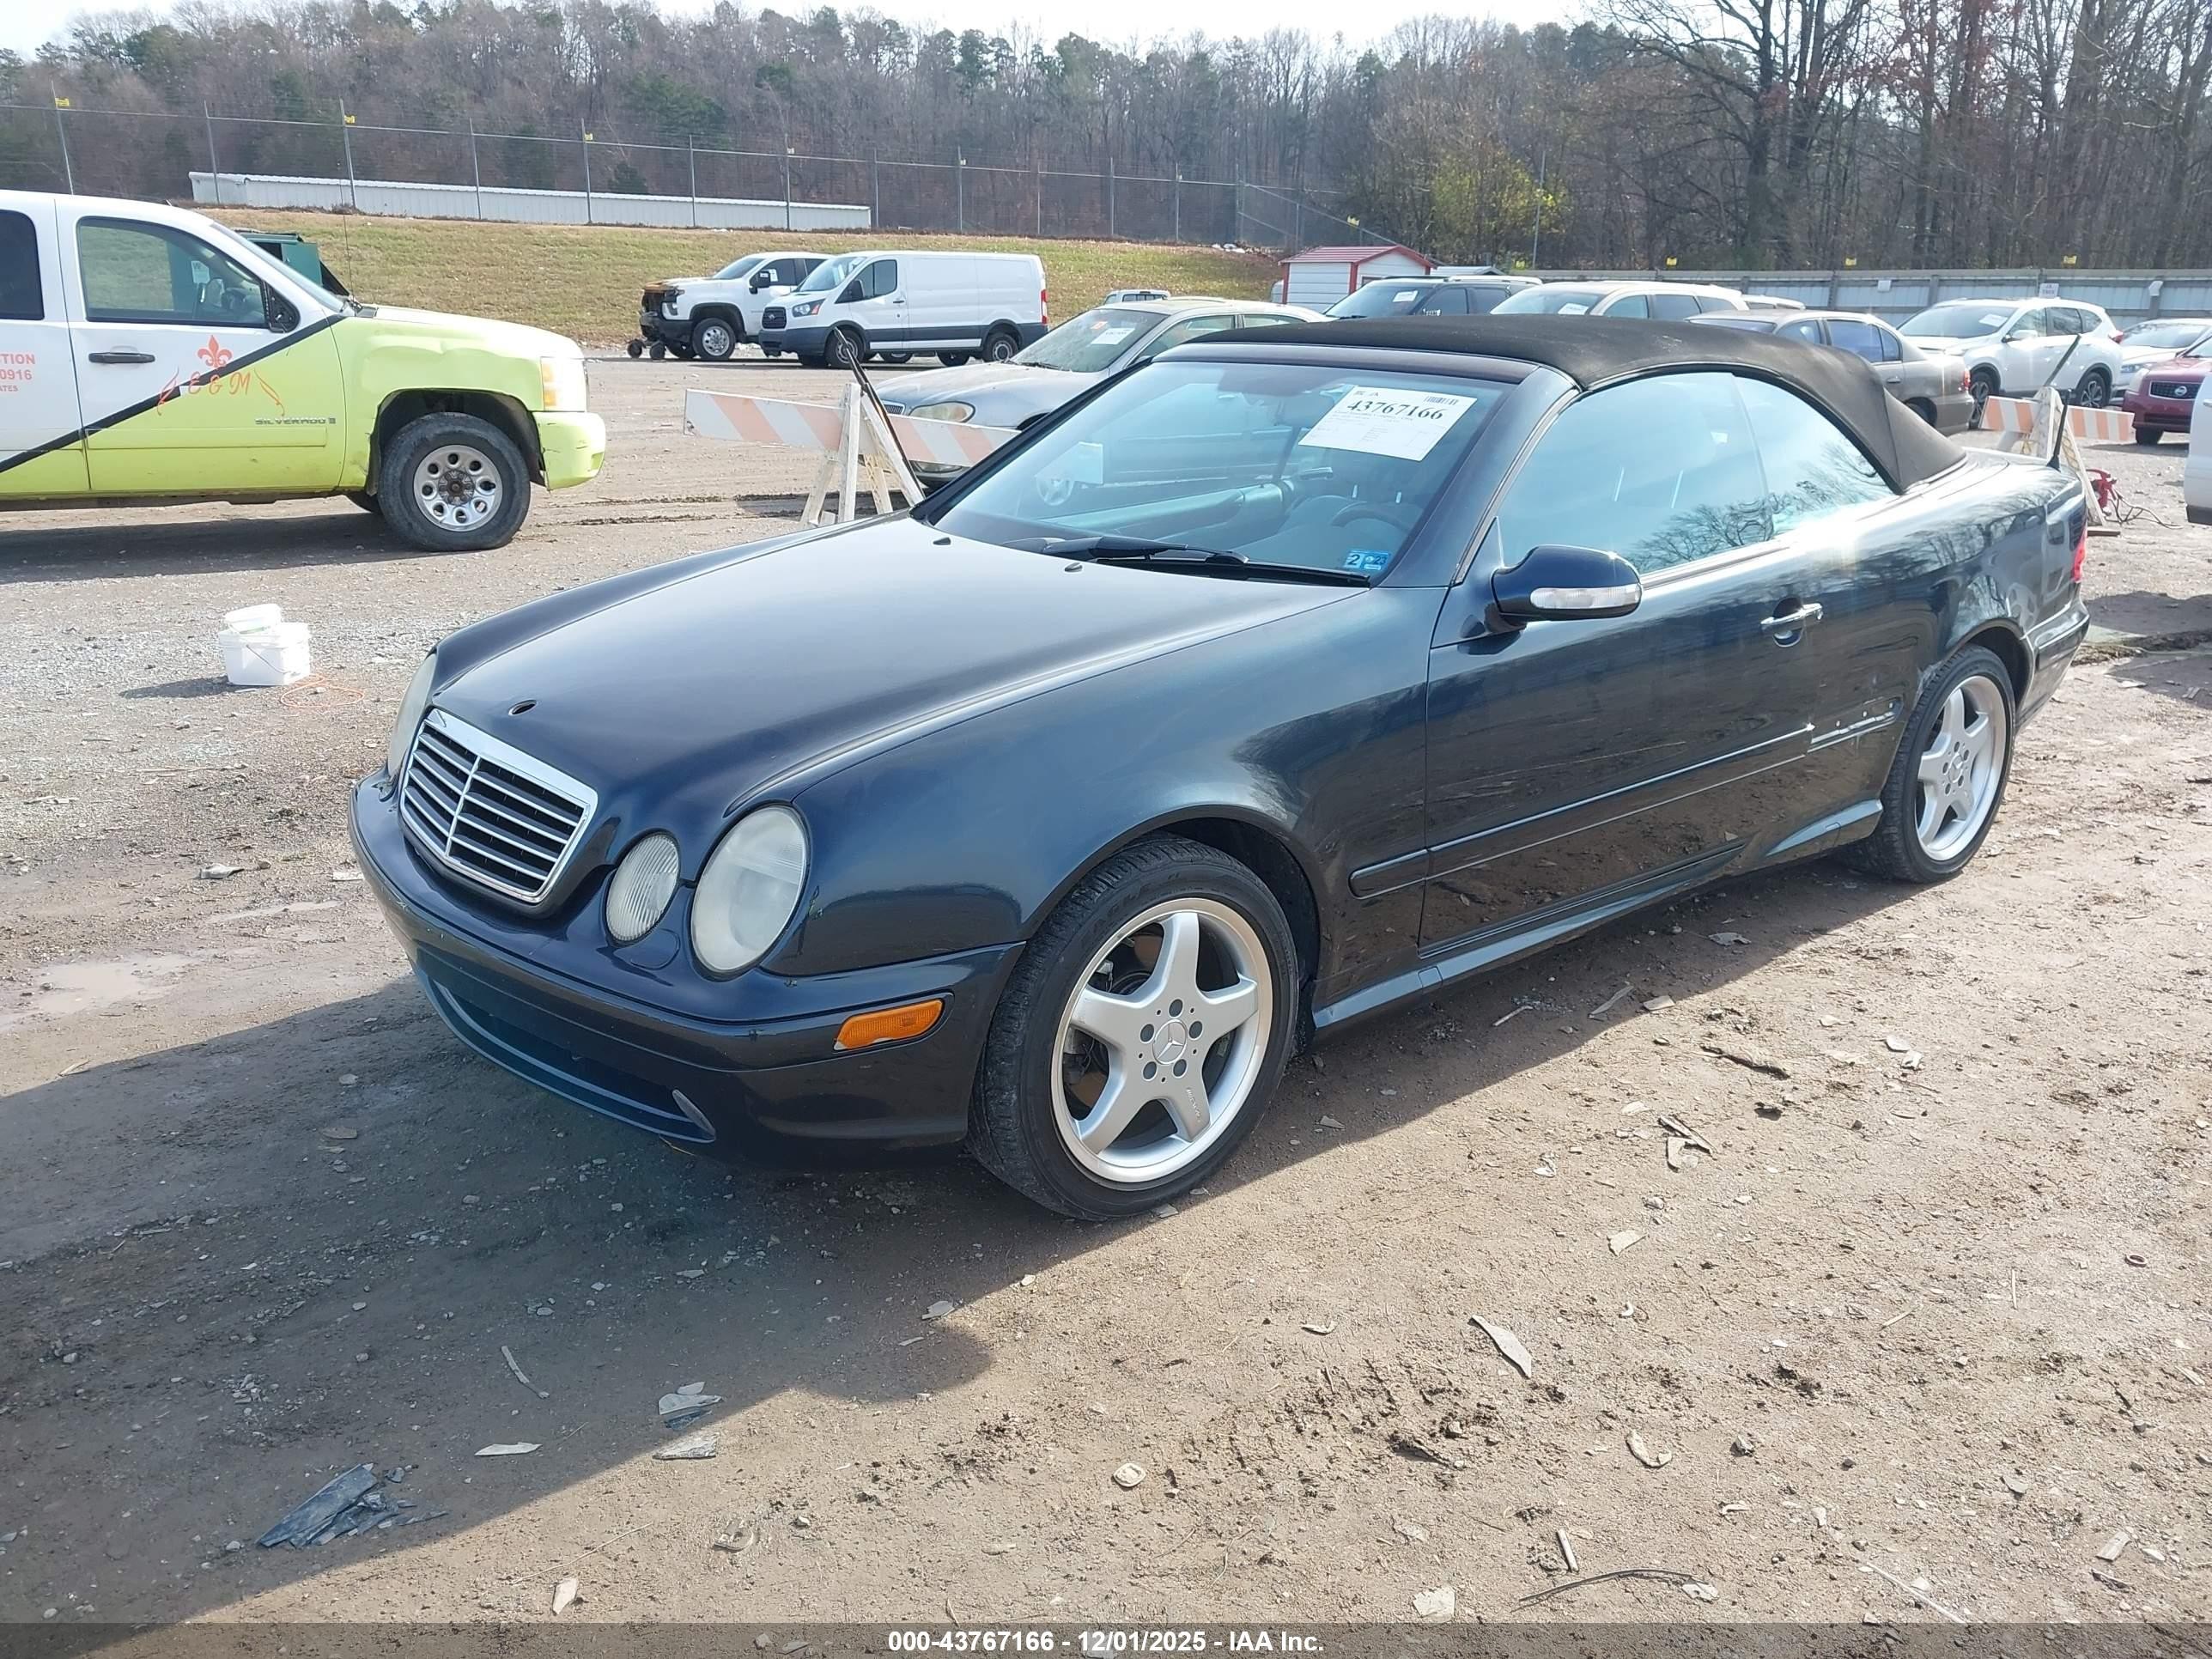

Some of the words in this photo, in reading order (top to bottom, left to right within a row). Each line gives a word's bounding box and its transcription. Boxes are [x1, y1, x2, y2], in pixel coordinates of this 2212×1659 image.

[0, 368, 33, 380] 0916
[188, 371, 201, 395] E
[209, 374, 223, 395] &
[229, 371, 252, 395] M
[1346, 400, 1447, 420] 43767166
[1348, 554, 1361, 566] 2
